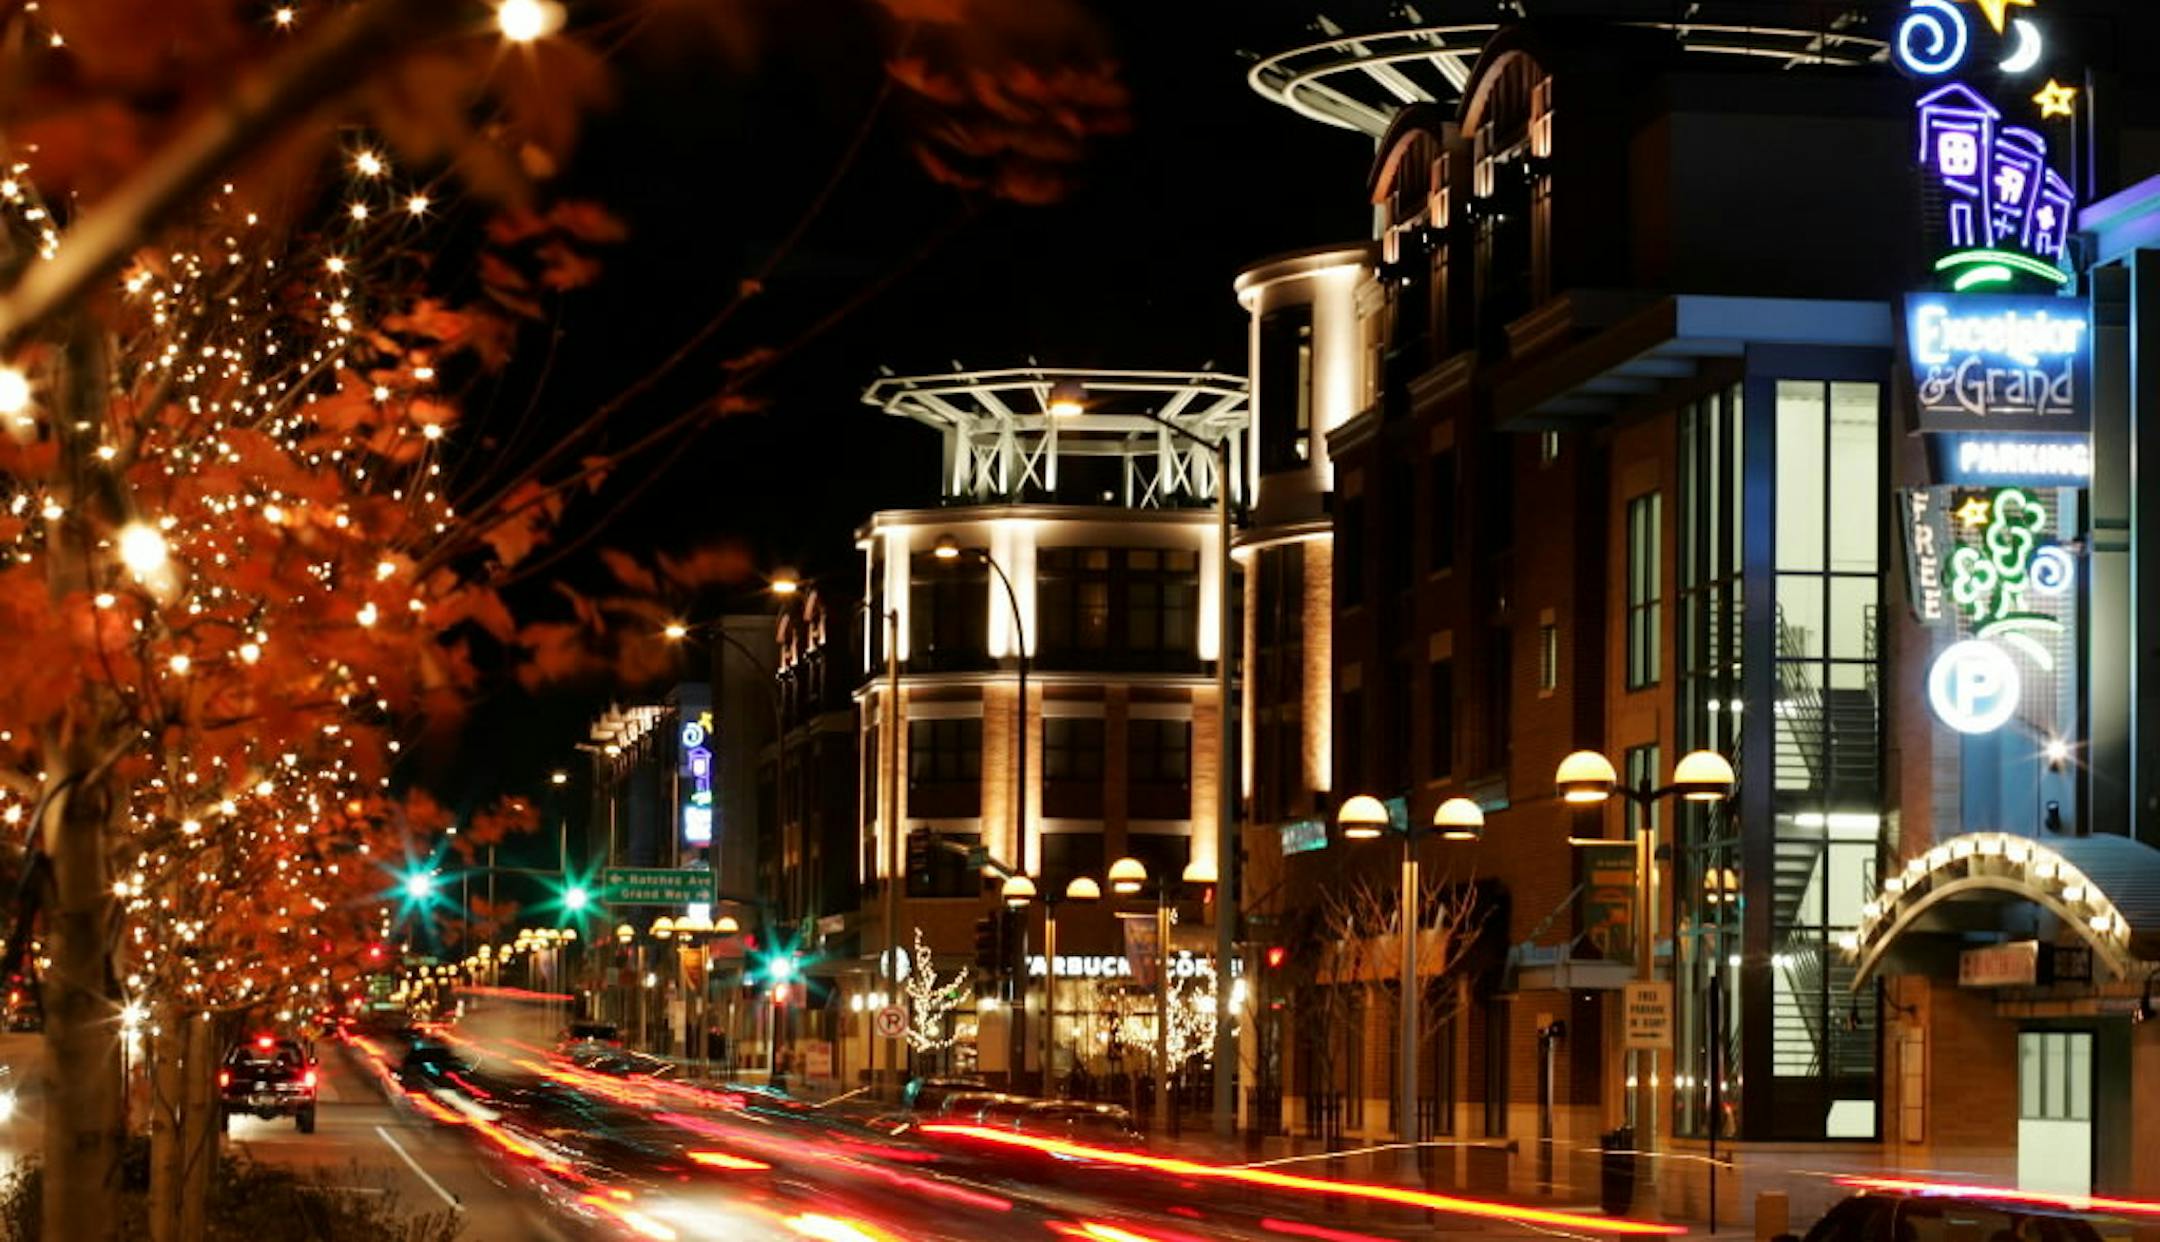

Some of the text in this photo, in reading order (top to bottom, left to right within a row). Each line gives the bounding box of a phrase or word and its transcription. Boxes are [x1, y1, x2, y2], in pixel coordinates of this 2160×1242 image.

[1917, 304, 2087, 367] Excelsior
[1960, 441, 2090, 476] PARKING
[1912, 492, 1942, 620] FREE
[622, 889, 659, 899] Grand
[688, 875, 711, 885] Ave
